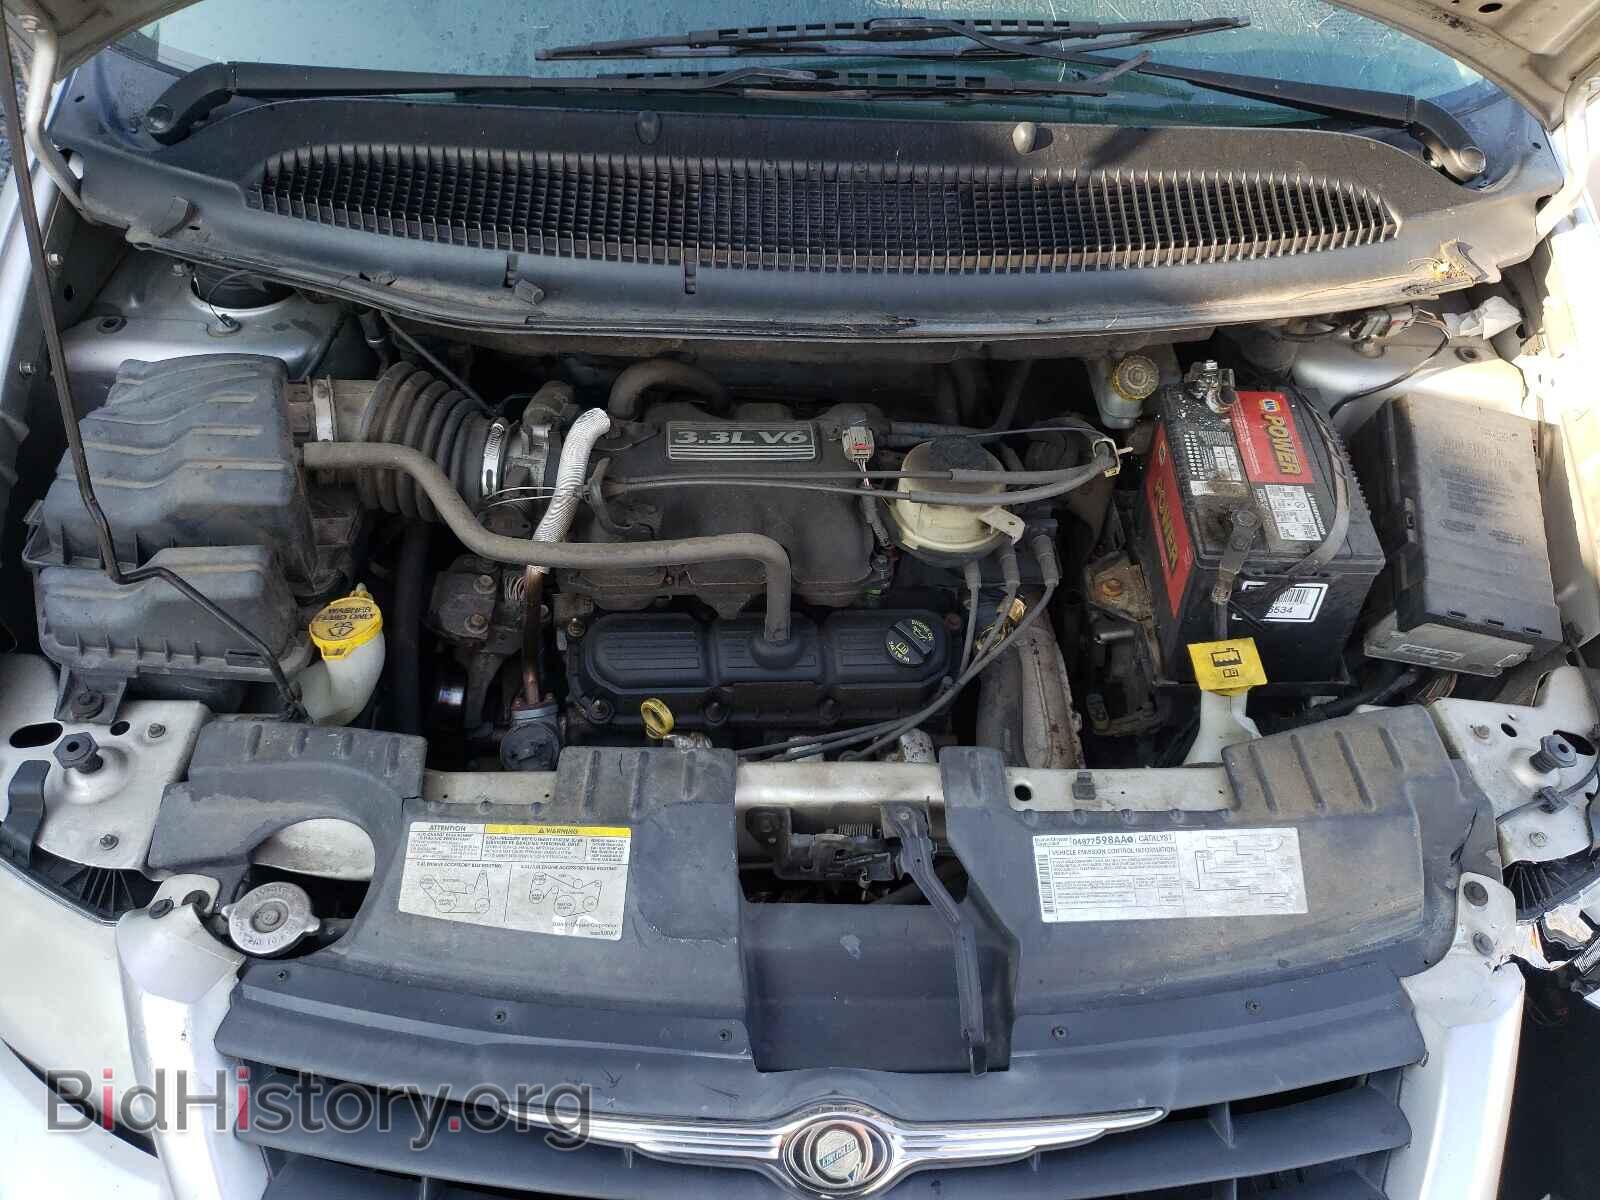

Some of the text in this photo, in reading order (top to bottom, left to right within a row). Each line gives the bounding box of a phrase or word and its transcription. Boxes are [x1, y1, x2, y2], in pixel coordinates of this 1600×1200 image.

[675, 431, 808, 444] 3.3L V6
[1261, 413, 1303, 476] POWER
[328, 606, 372, 614] WASHER
[546, 827, 578, 835] WARNING
[1138, 833, 1173, 842] CATALYST
[1051, 848, 1077, 856] VEHICLE
